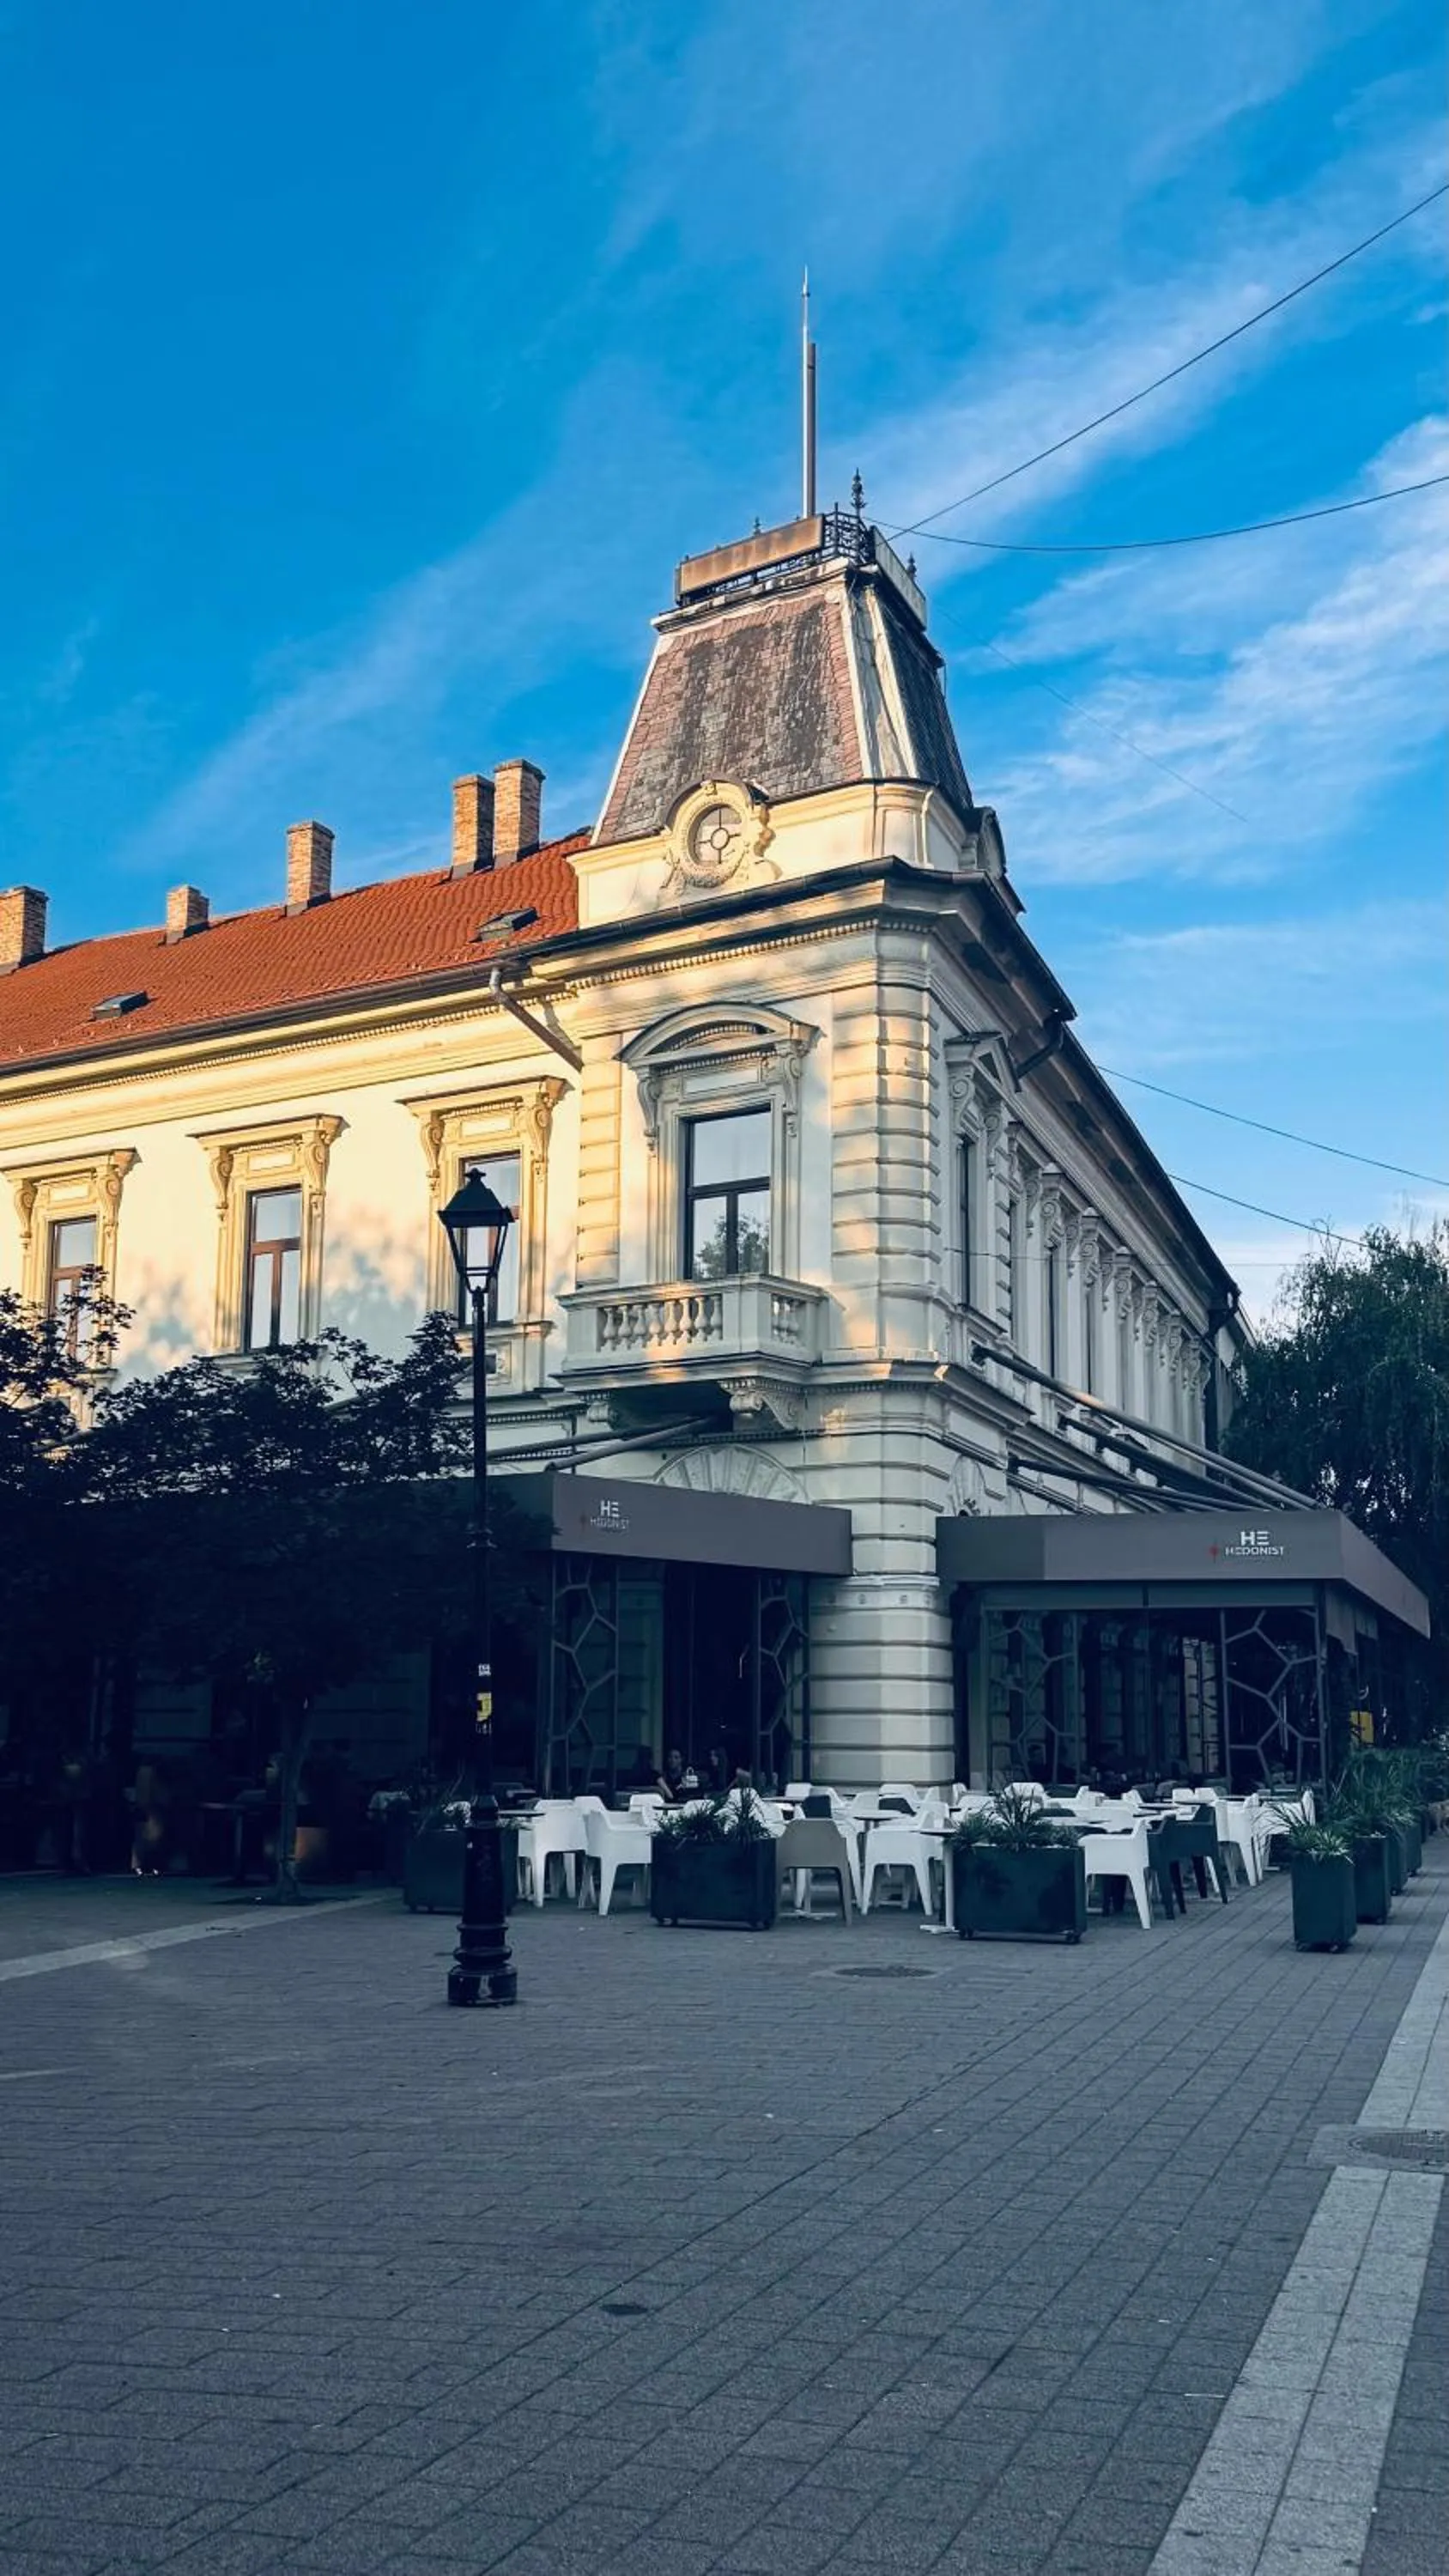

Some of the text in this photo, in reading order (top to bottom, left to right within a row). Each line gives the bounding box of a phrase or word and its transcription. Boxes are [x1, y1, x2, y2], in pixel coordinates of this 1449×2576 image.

[600, 1500, 619, 1517] HE
[1240, 1530, 1270, 1546] HE
[1225, 1546, 1283, 1556] HEDONIST
